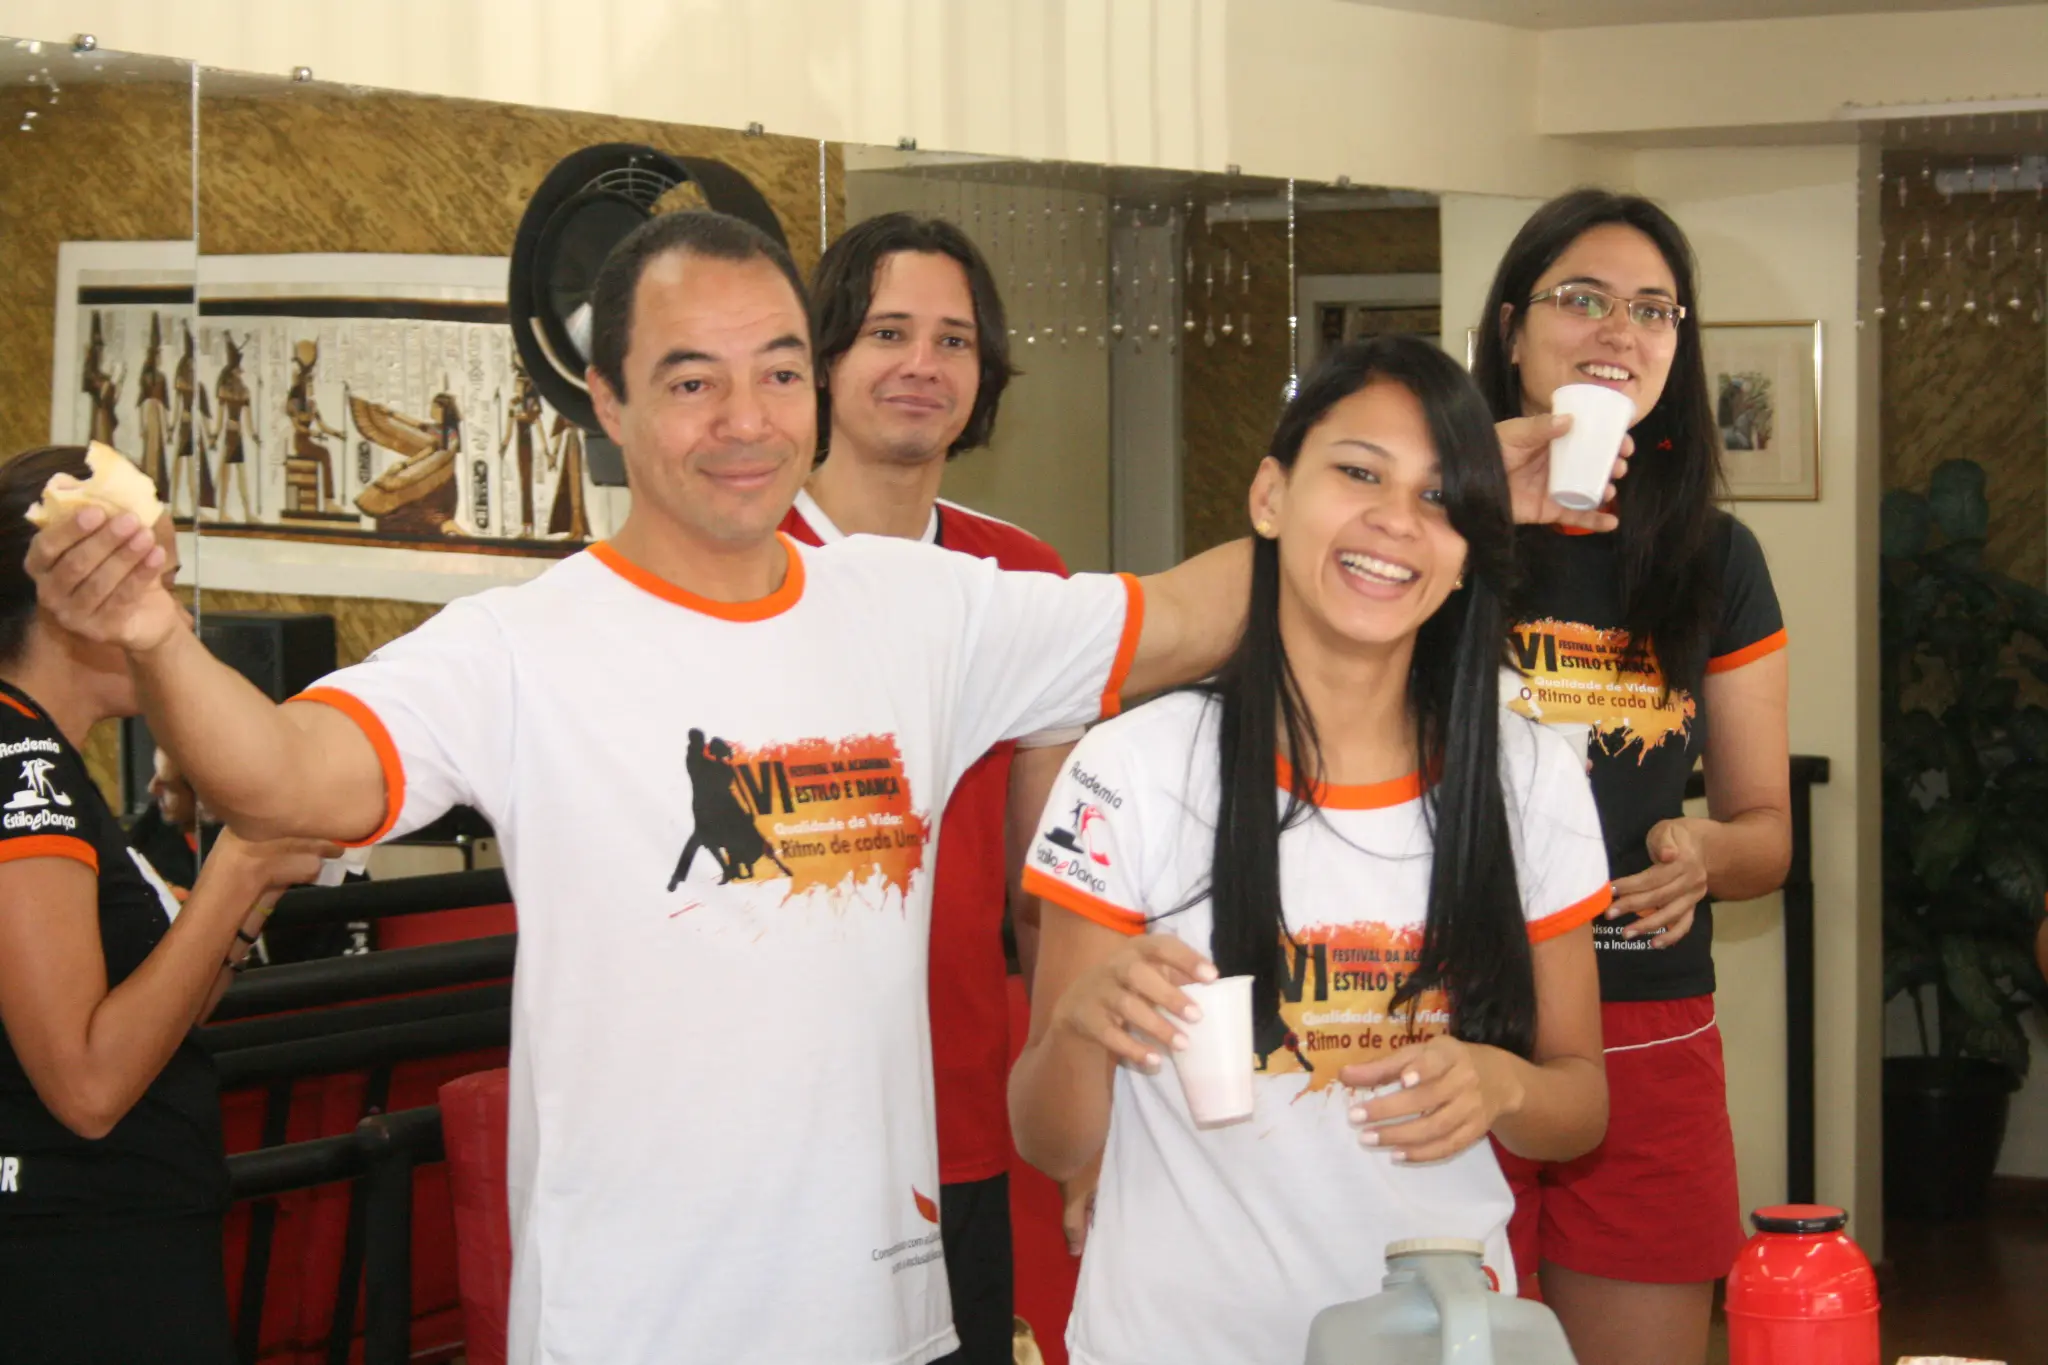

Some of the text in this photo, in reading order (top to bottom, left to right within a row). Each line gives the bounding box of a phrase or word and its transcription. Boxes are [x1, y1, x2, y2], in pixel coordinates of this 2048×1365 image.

[1511, 632, 1558, 672] VI
[1559, 640, 1594, 653] FESTIVAL
[1561, 655, 1601, 671] ESTILO
[1604, 659, 1612, 671] E
[1534, 676, 1602, 691] Qualidade
[1605, 682, 1622, 692] de
[1520, 687, 1675, 712] O Ritmo de cada Um
[0, 736, 60, 759] Academia
[738, 761, 794, 815] VI
[795, 777, 900, 804] ESTILO E DANÇA
[1069, 761, 1123, 810] Academia
[774, 818, 845, 835] Qualidade
[848, 814, 866, 829] de
[781, 830, 919, 859] Ritmo de cada Um
[1333, 949, 1381, 963] FESTIVAL
[1385, 949, 1399, 963] DA
[1612, 939, 1646, 950] Inclusão
[1279, 943, 1329, 1003] VI
[1334, 971, 1388, 992] ESTILO
[1301, 1009, 1382, 1026] Qualidade
[1307, 1030, 1352, 1052] Ritmo
[1358, 1028, 1381, 1049] de
